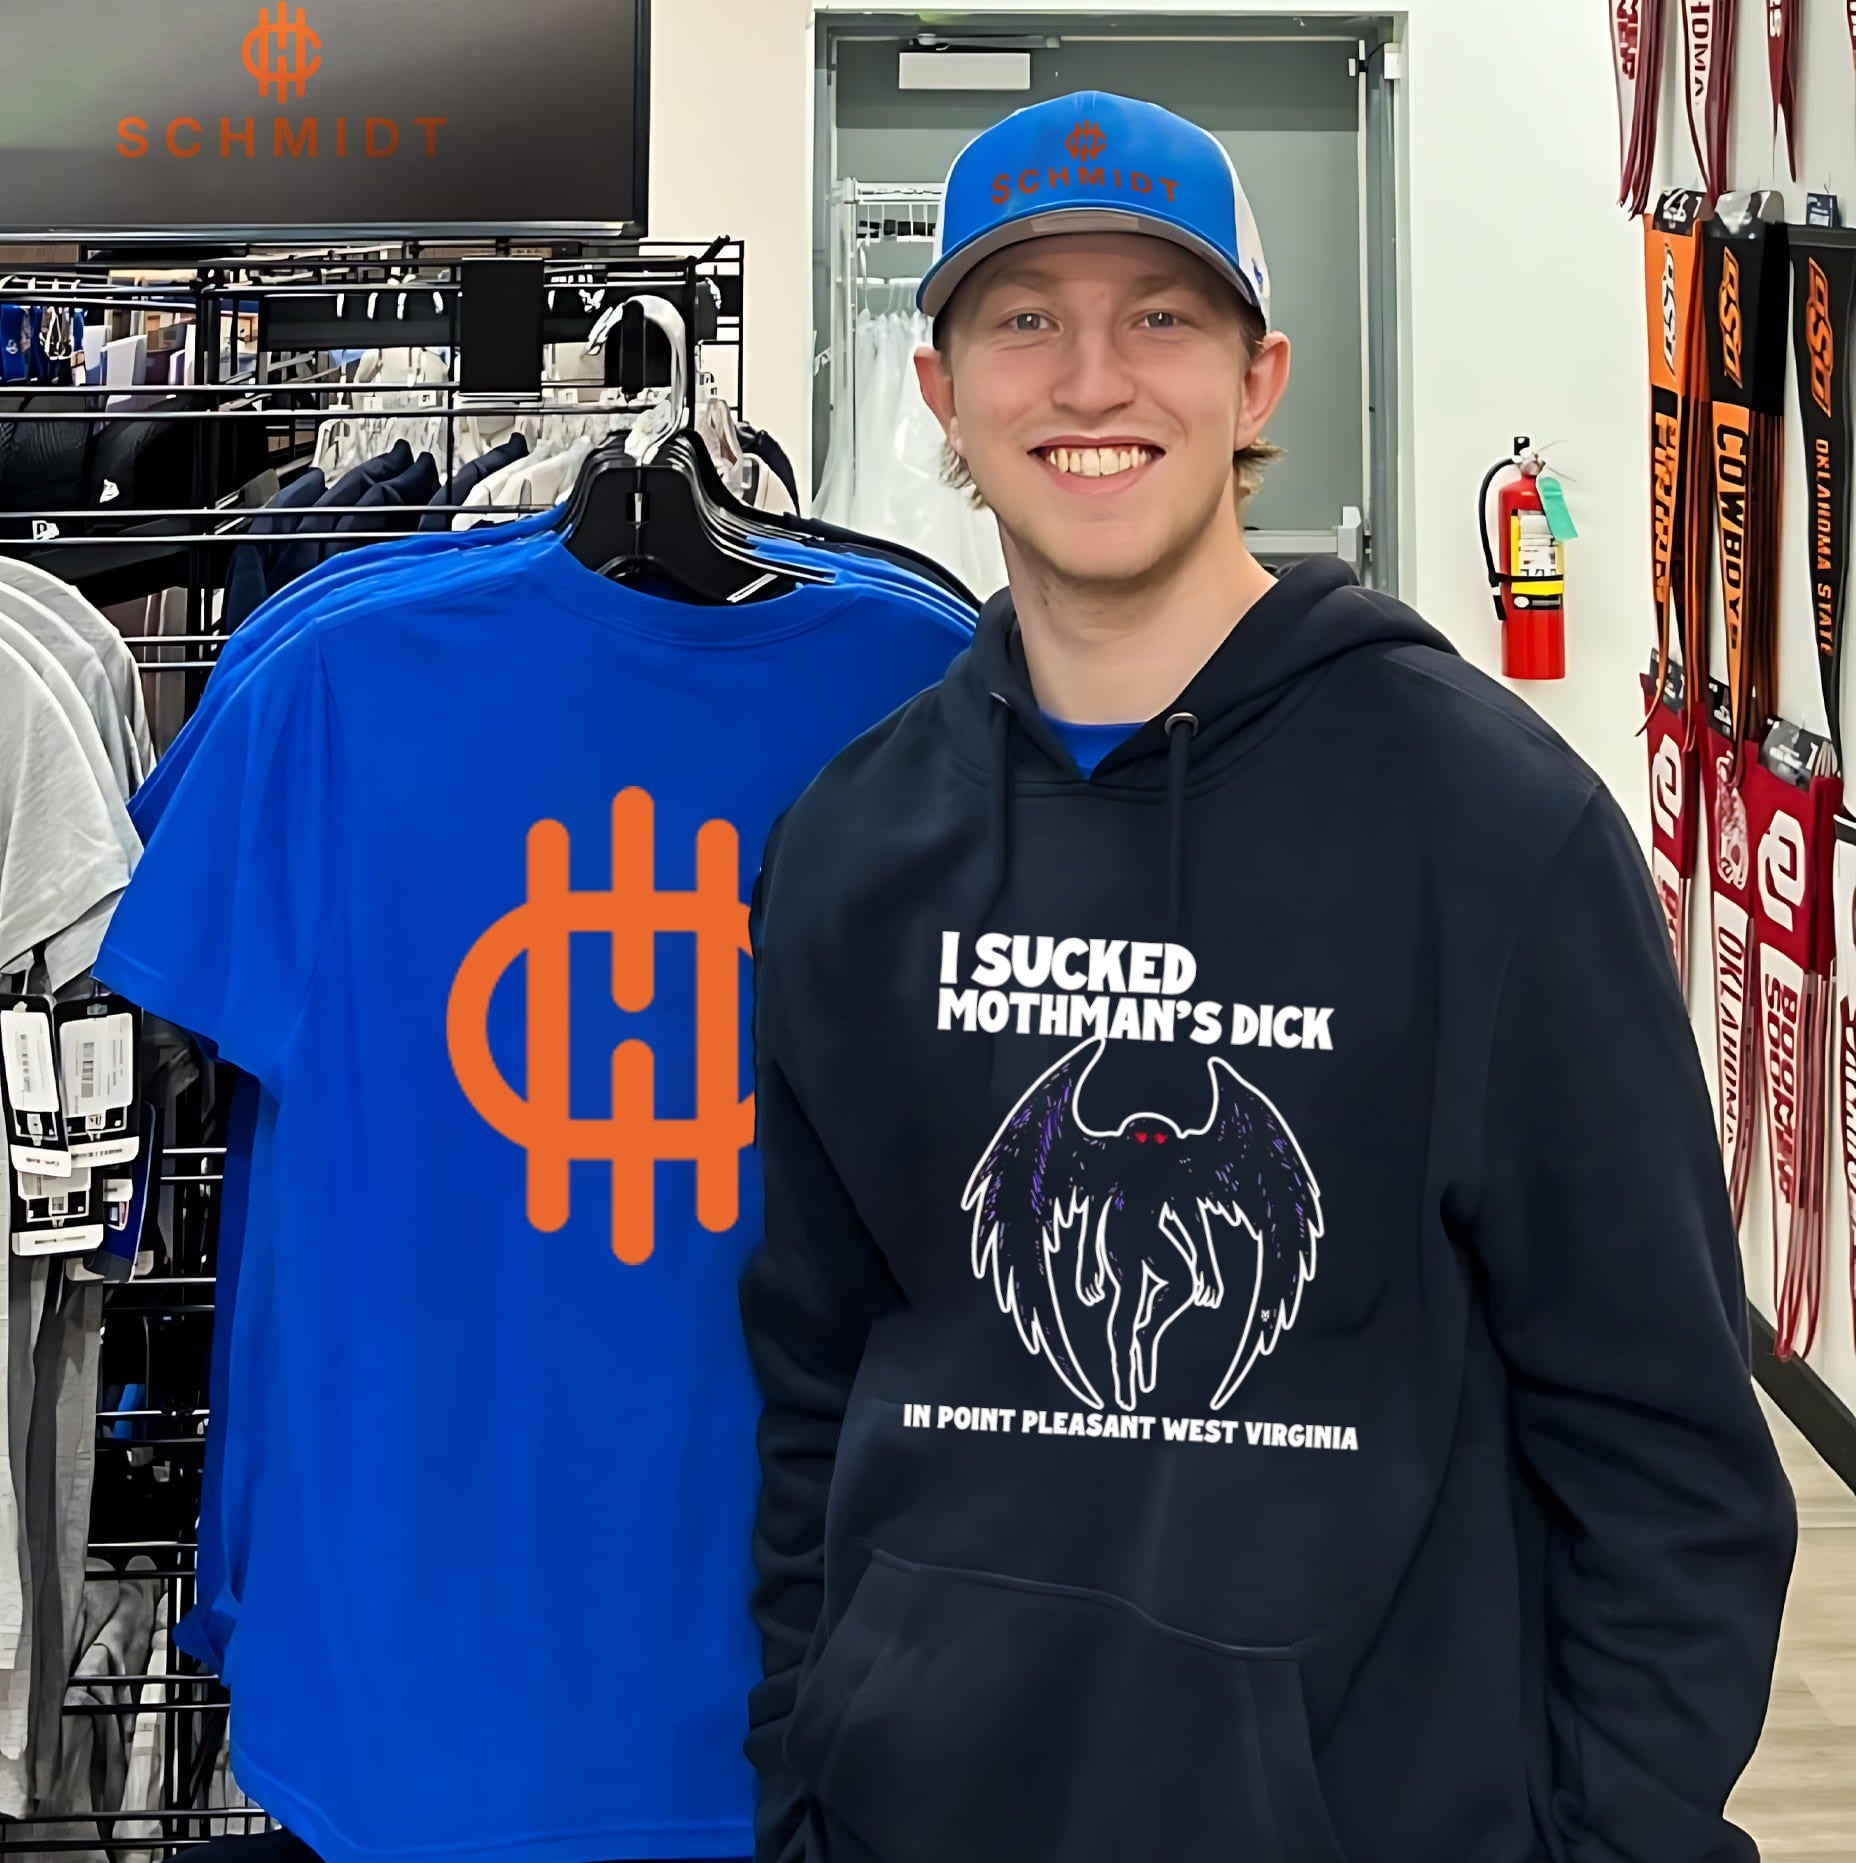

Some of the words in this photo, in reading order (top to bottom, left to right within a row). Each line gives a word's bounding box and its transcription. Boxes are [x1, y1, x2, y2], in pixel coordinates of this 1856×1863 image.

[115, 116, 447, 159] SCHMIDT
[991, 167, 1179, 205] SCHMIDT
[1815, 438, 1832, 570] OKLAHOMA
[940, 931, 960, 985] I
[971, 932, 1197, 996] SUCKED
[937, 987, 1224, 1046] MOTHMAN'S
[1231, 1003, 1334, 1050] DICK
[1718, 926, 1745, 1144] OKLAHOMA
[903, 1403, 931, 1428] IN
[937, 1404, 1016, 1432] POINT
[1021, 1409, 1156, 1440] PLEASANT
[1161, 1416, 1239, 1445] WEST
[1244, 1421, 1359, 1451] VIRGINIA
